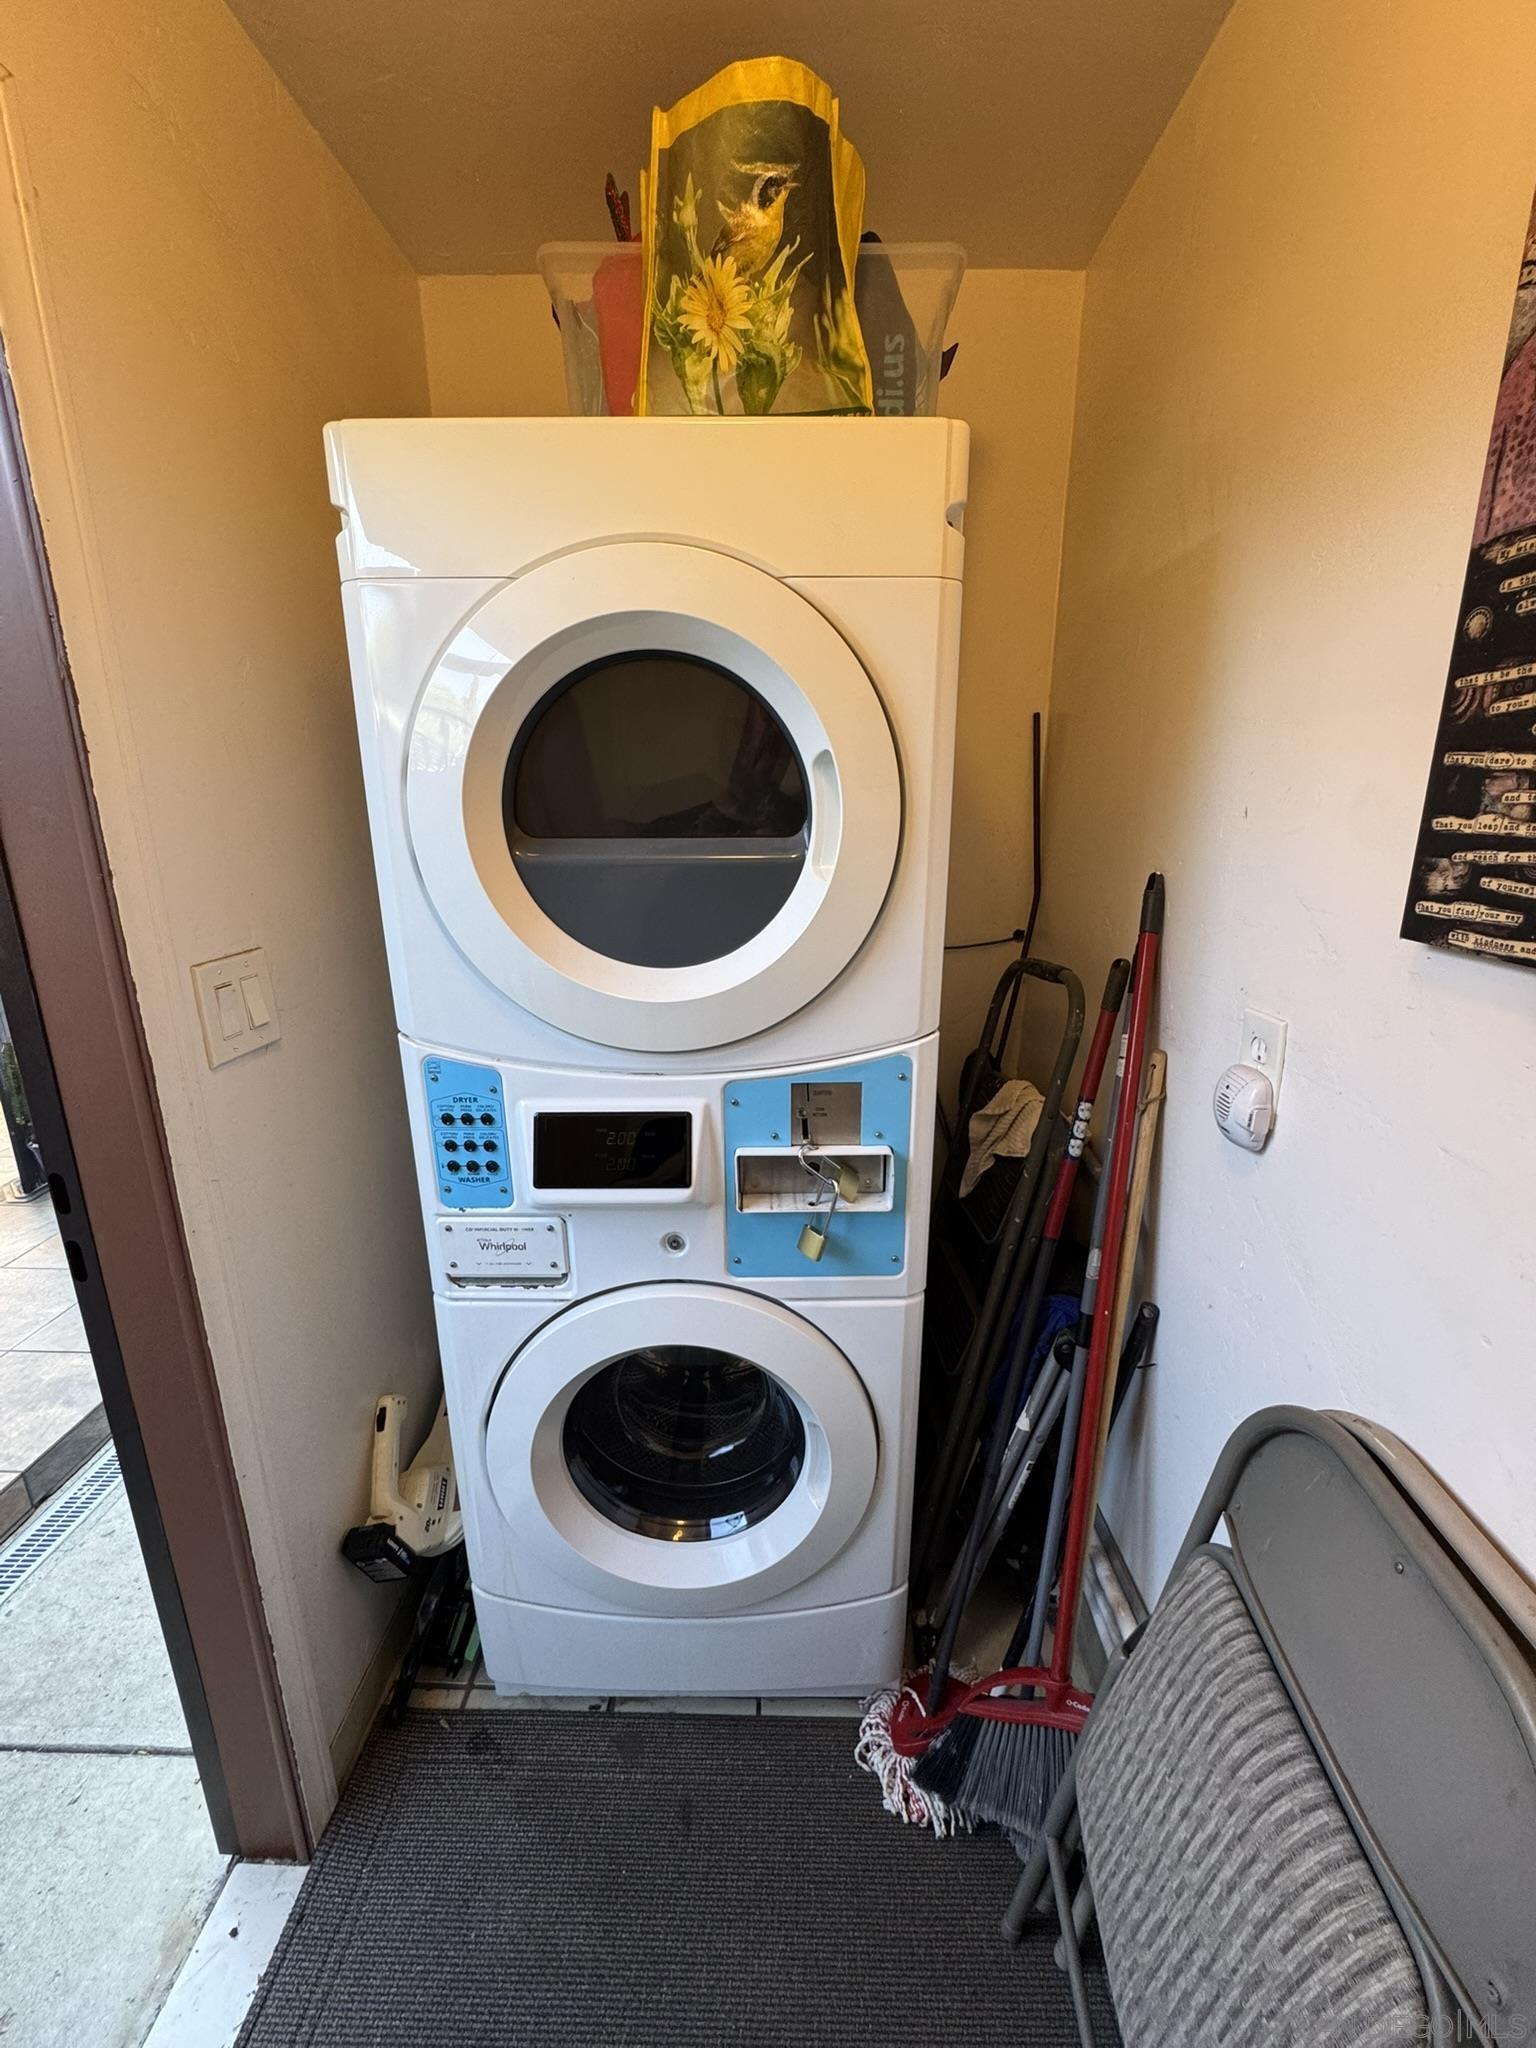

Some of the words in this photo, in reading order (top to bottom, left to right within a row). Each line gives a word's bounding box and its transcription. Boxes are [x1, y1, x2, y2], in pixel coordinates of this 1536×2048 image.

[1517, 666, 1533, 675] the
[1506, 699, 1530, 711] your
[1469, 757, 1484, 766] you
[1489, 756, 1511, 765] dare
[1504, 794, 1521, 802] and
[1458, 822, 1473, 831] you
[1503, 823, 1520, 831] and
[1453, 853, 1468, 861] and
[1473, 853, 1499, 862] reach
[1503, 854, 1521, 862] for
[1481, 879, 1491, 887] of
[1496, 882, 1536, 897] yoursel
[1437, 906, 1452, 914] you
[1455, 907, 1475, 916] find
[1479, 911, 1501, 920] your
[1505, 914, 1522, 924] way
[1450, 932, 1470, 942] with
[1473, 935, 1515, 953] kindness
[452, 1096, 480, 1104] DRYER
[478, 1241, 527, 1253] Whirlpool
